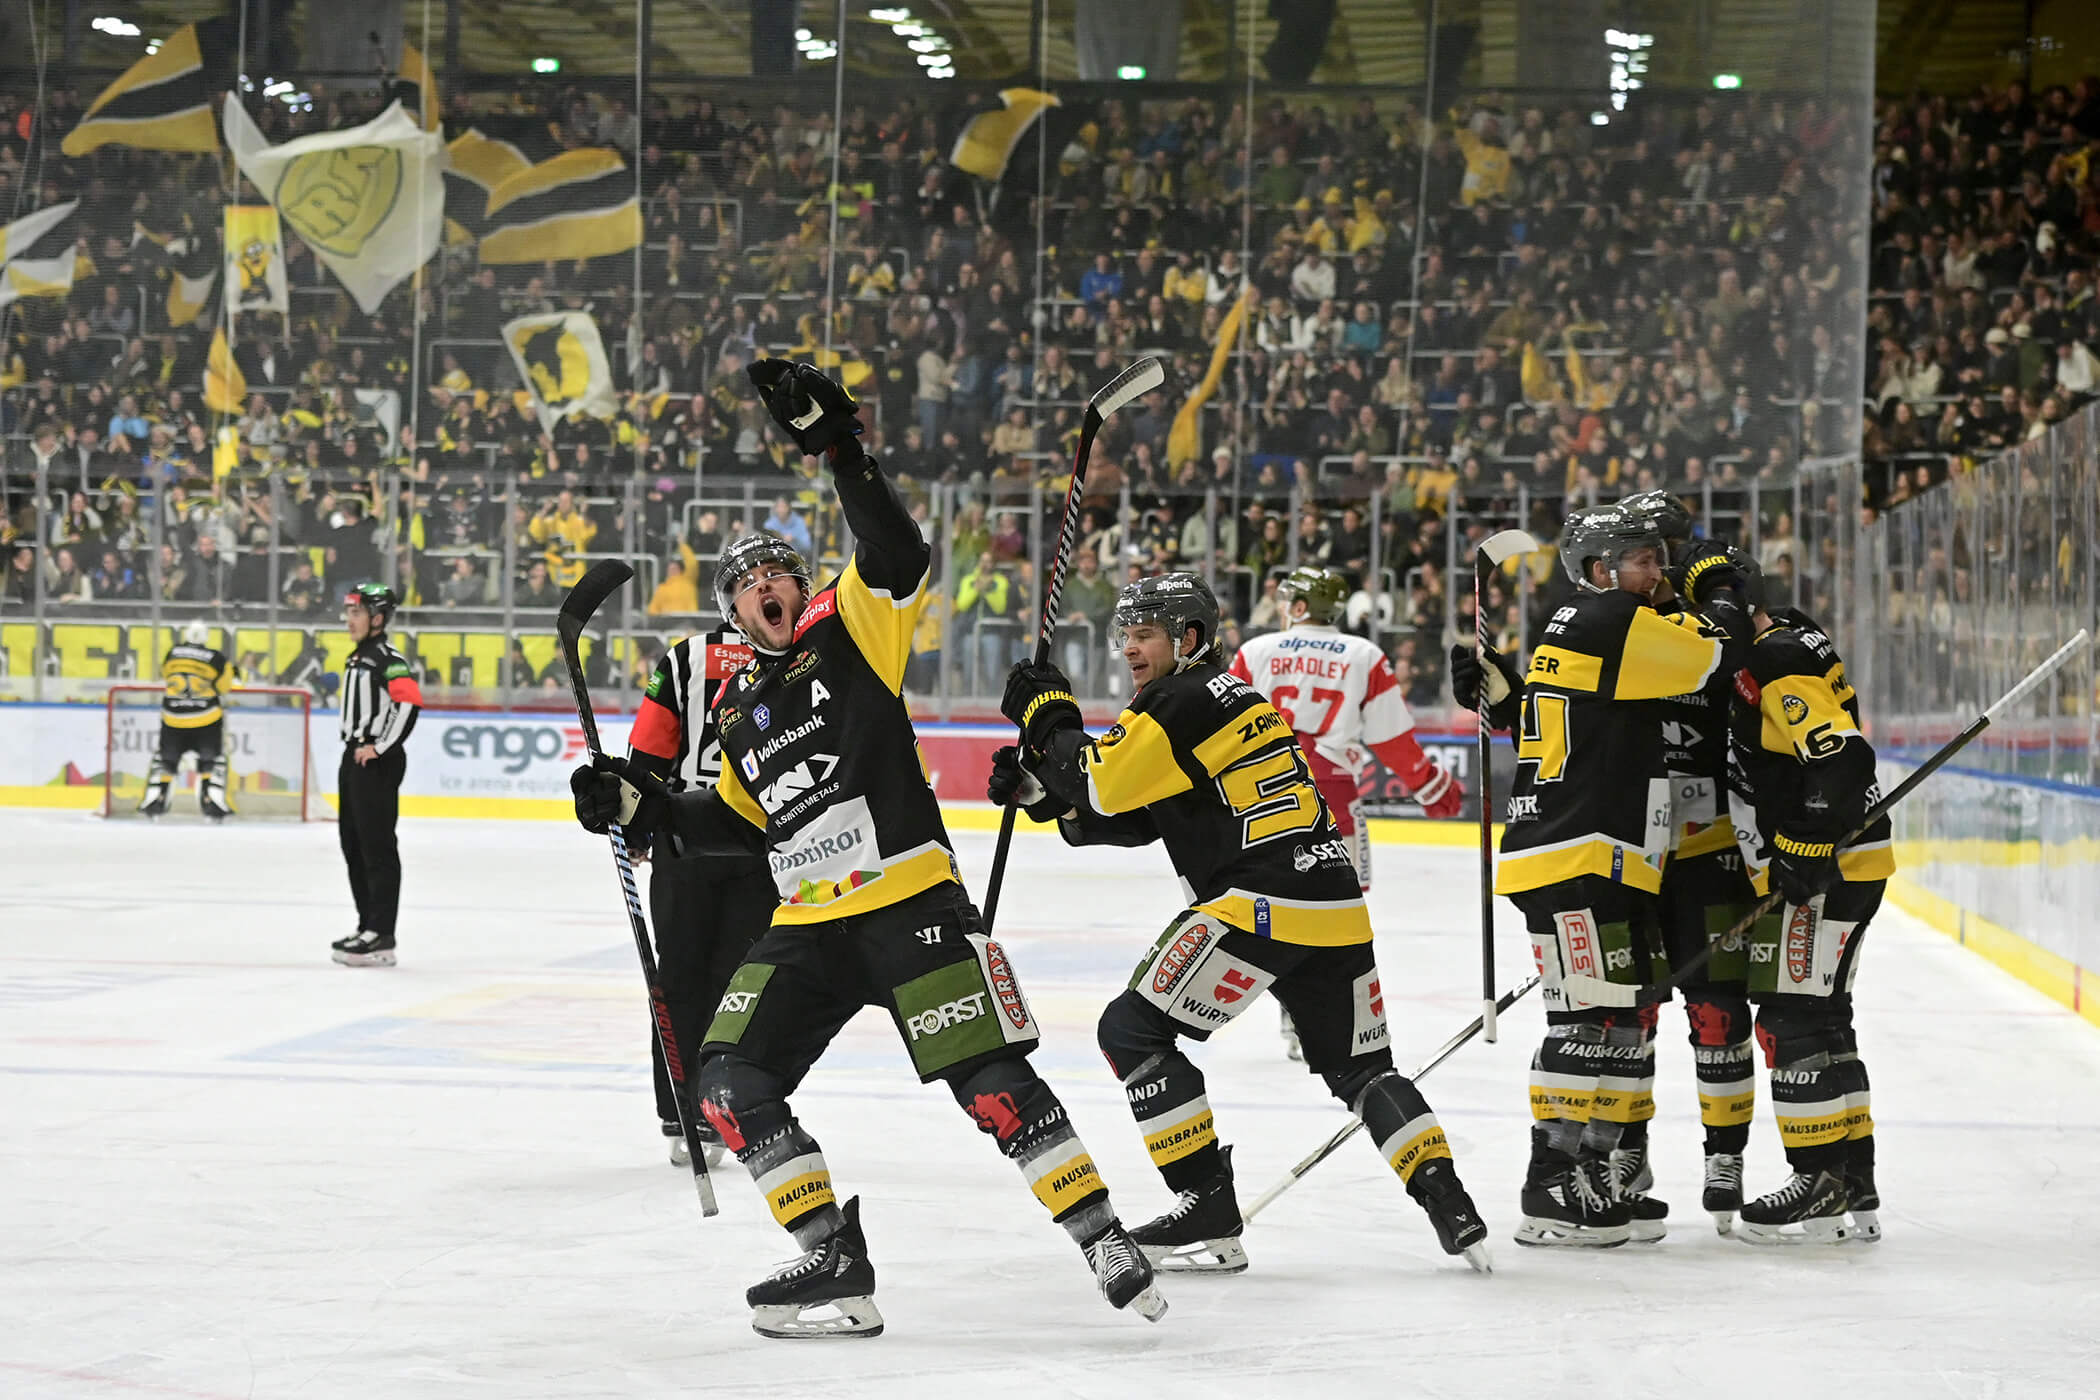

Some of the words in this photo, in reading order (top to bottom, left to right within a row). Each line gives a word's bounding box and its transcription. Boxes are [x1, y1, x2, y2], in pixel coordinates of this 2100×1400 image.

[1156, 579, 1193, 592] alperia
[714, 647, 728, 657] Es
[729, 650, 752, 661] lebe
[784, 653, 818, 682] PIRCHER
[1271, 657, 1350, 681] BRADLEY
[1279, 637, 1347, 654] alperia
[1528, 655, 1561, 675] ER
[811, 678, 831, 708] A
[1271, 685, 1345, 735] 67
[442, 725, 563, 774] engo
[757, 715, 826, 763] Volksbank
[805, 782, 840, 807] METALS
[1214, 745, 1338, 850] 5
[1156, 929, 1205, 988] GERAX
[1568, 921, 1593, 978] FAS
[1789, 911, 1808, 977] GERAX
[990, 948, 1022, 1022] GERAX
[907, 991, 986, 1041] FORST
